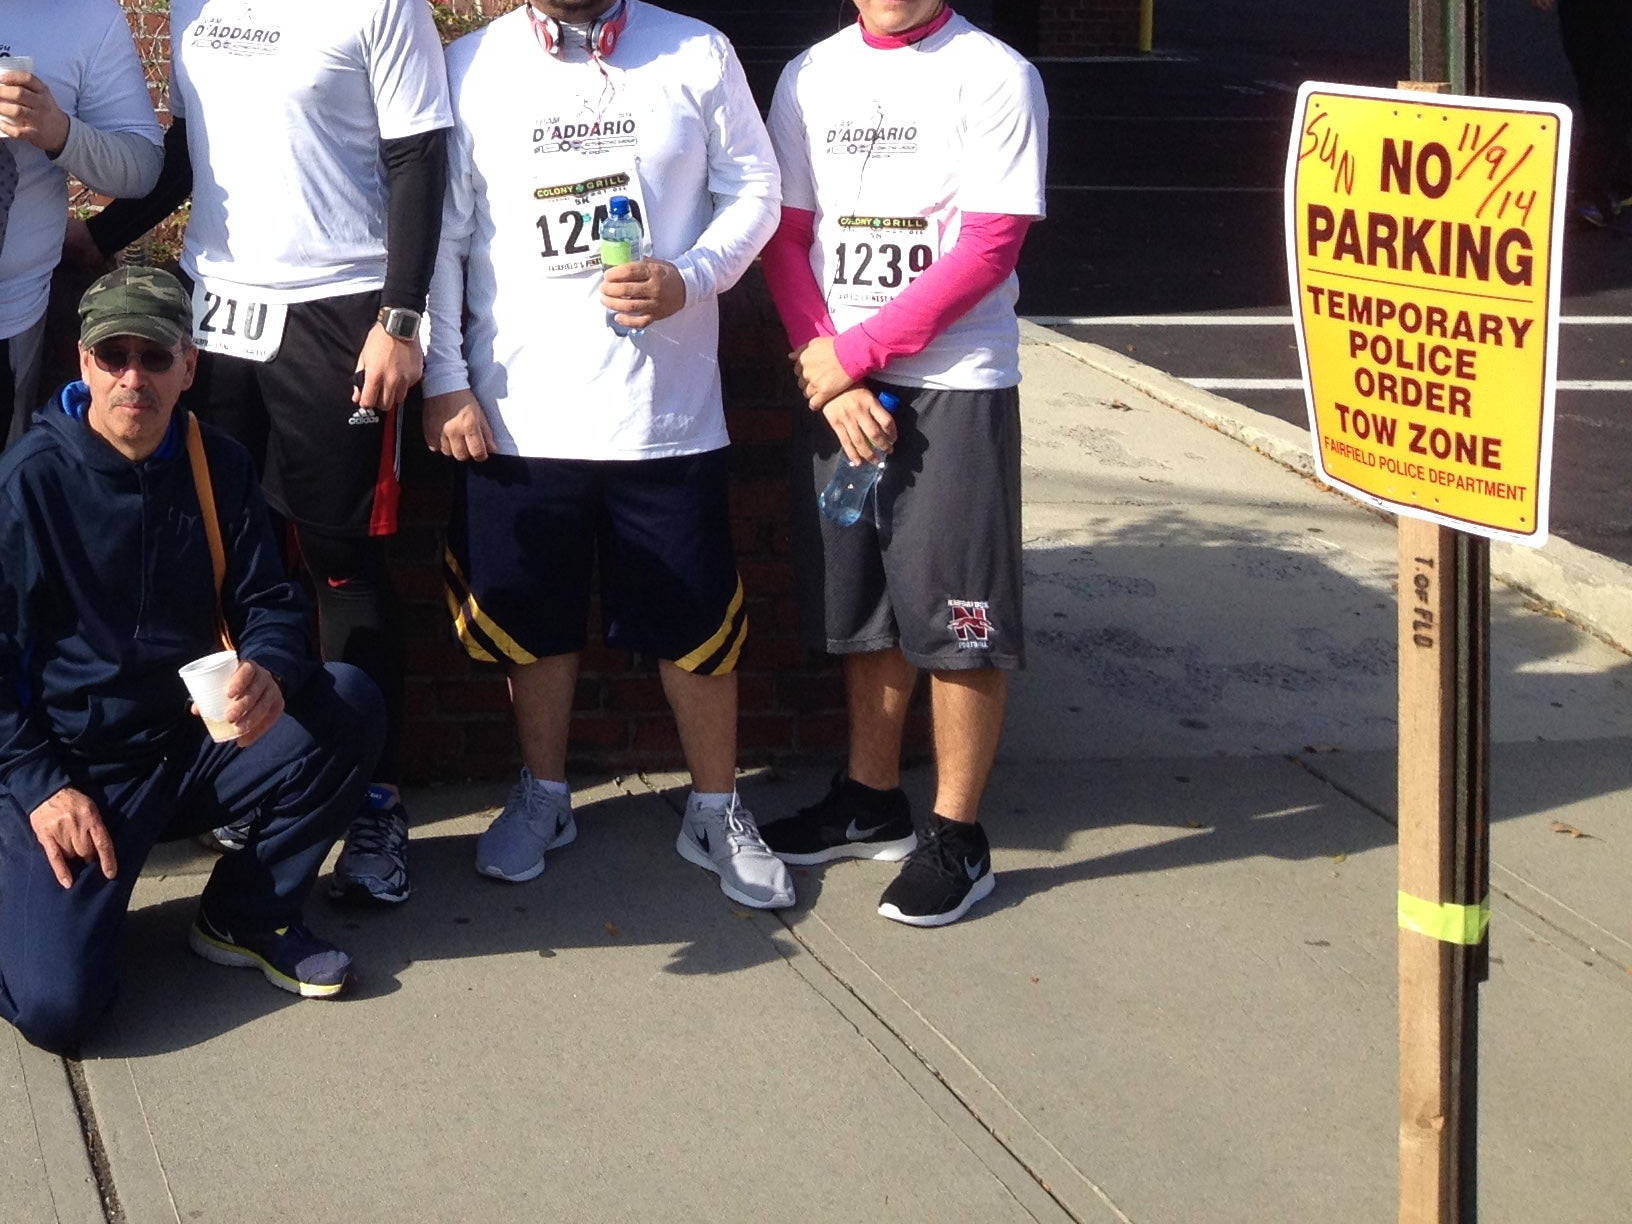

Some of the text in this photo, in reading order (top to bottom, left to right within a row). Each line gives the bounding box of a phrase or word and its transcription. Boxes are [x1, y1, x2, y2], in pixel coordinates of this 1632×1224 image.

[532, 119, 636, 142] D'ADDARIO
[826, 126, 918, 143] D'ADDARIO
[1299, 112, 1355, 196] SUN
[536, 176, 626, 198] COLONY GRILL
[1380, 137, 1452, 199] NO
[882, 217, 923, 227] GRILL
[1308, 203, 1533, 286] PARKING
[833, 242, 933, 288] 1239
[1307, 284, 1534, 348] TEMPORARY
[1349, 329, 1477, 381] POLICE
[1354, 367, 1472, 418] ORDER
[1334, 402, 1502, 470] TOW ZONE
[1324, 436, 1526, 502] FAIRFIELD POLICE DEPARTMENT
